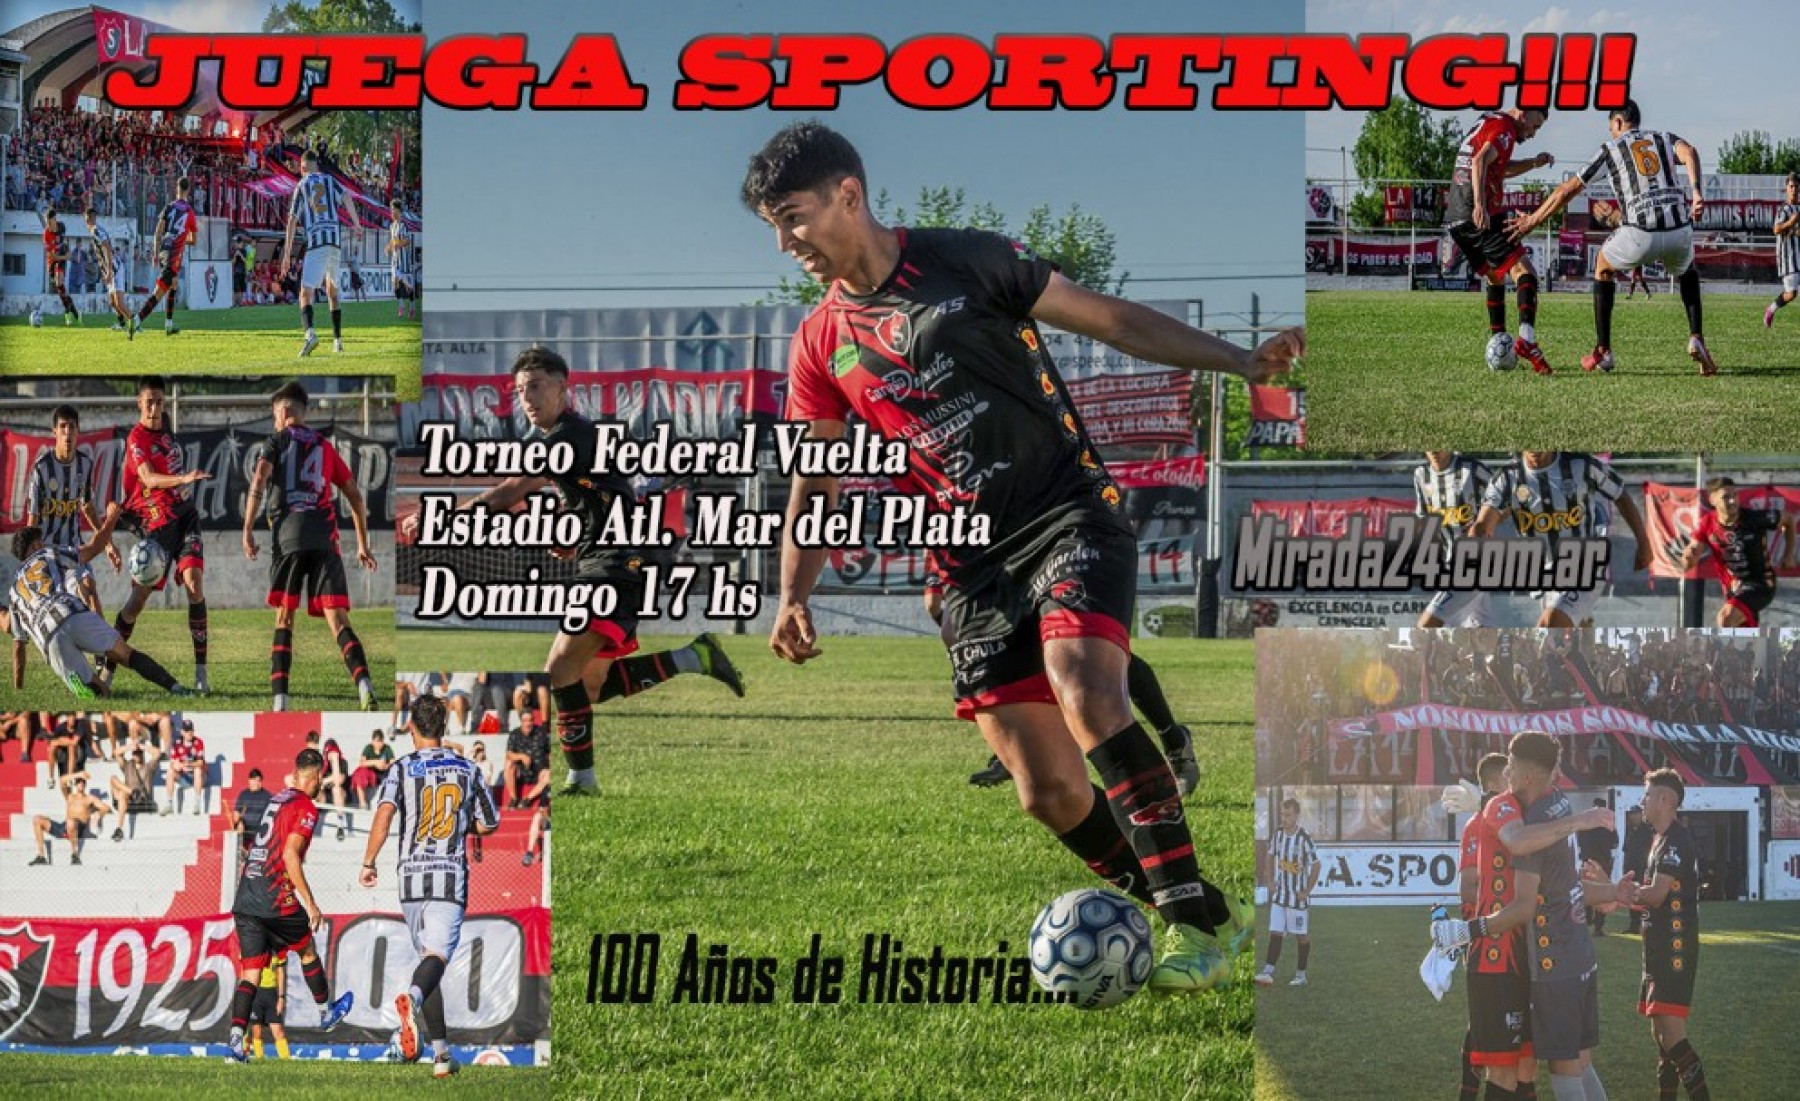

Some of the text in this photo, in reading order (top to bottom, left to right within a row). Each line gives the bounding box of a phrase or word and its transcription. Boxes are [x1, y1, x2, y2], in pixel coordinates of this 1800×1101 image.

[1629, 139, 1660, 177] 6
[1502, 192, 1542, 206] ANGRE
[1701, 203, 1743, 229] AMOS
[280, 441, 326, 493] 14
[1288, 601, 1373, 614] EXCELENCIA
[254, 802, 282, 847] 5
[416, 783, 463, 843] 10
[73, 917, 238, 1041] 1925
